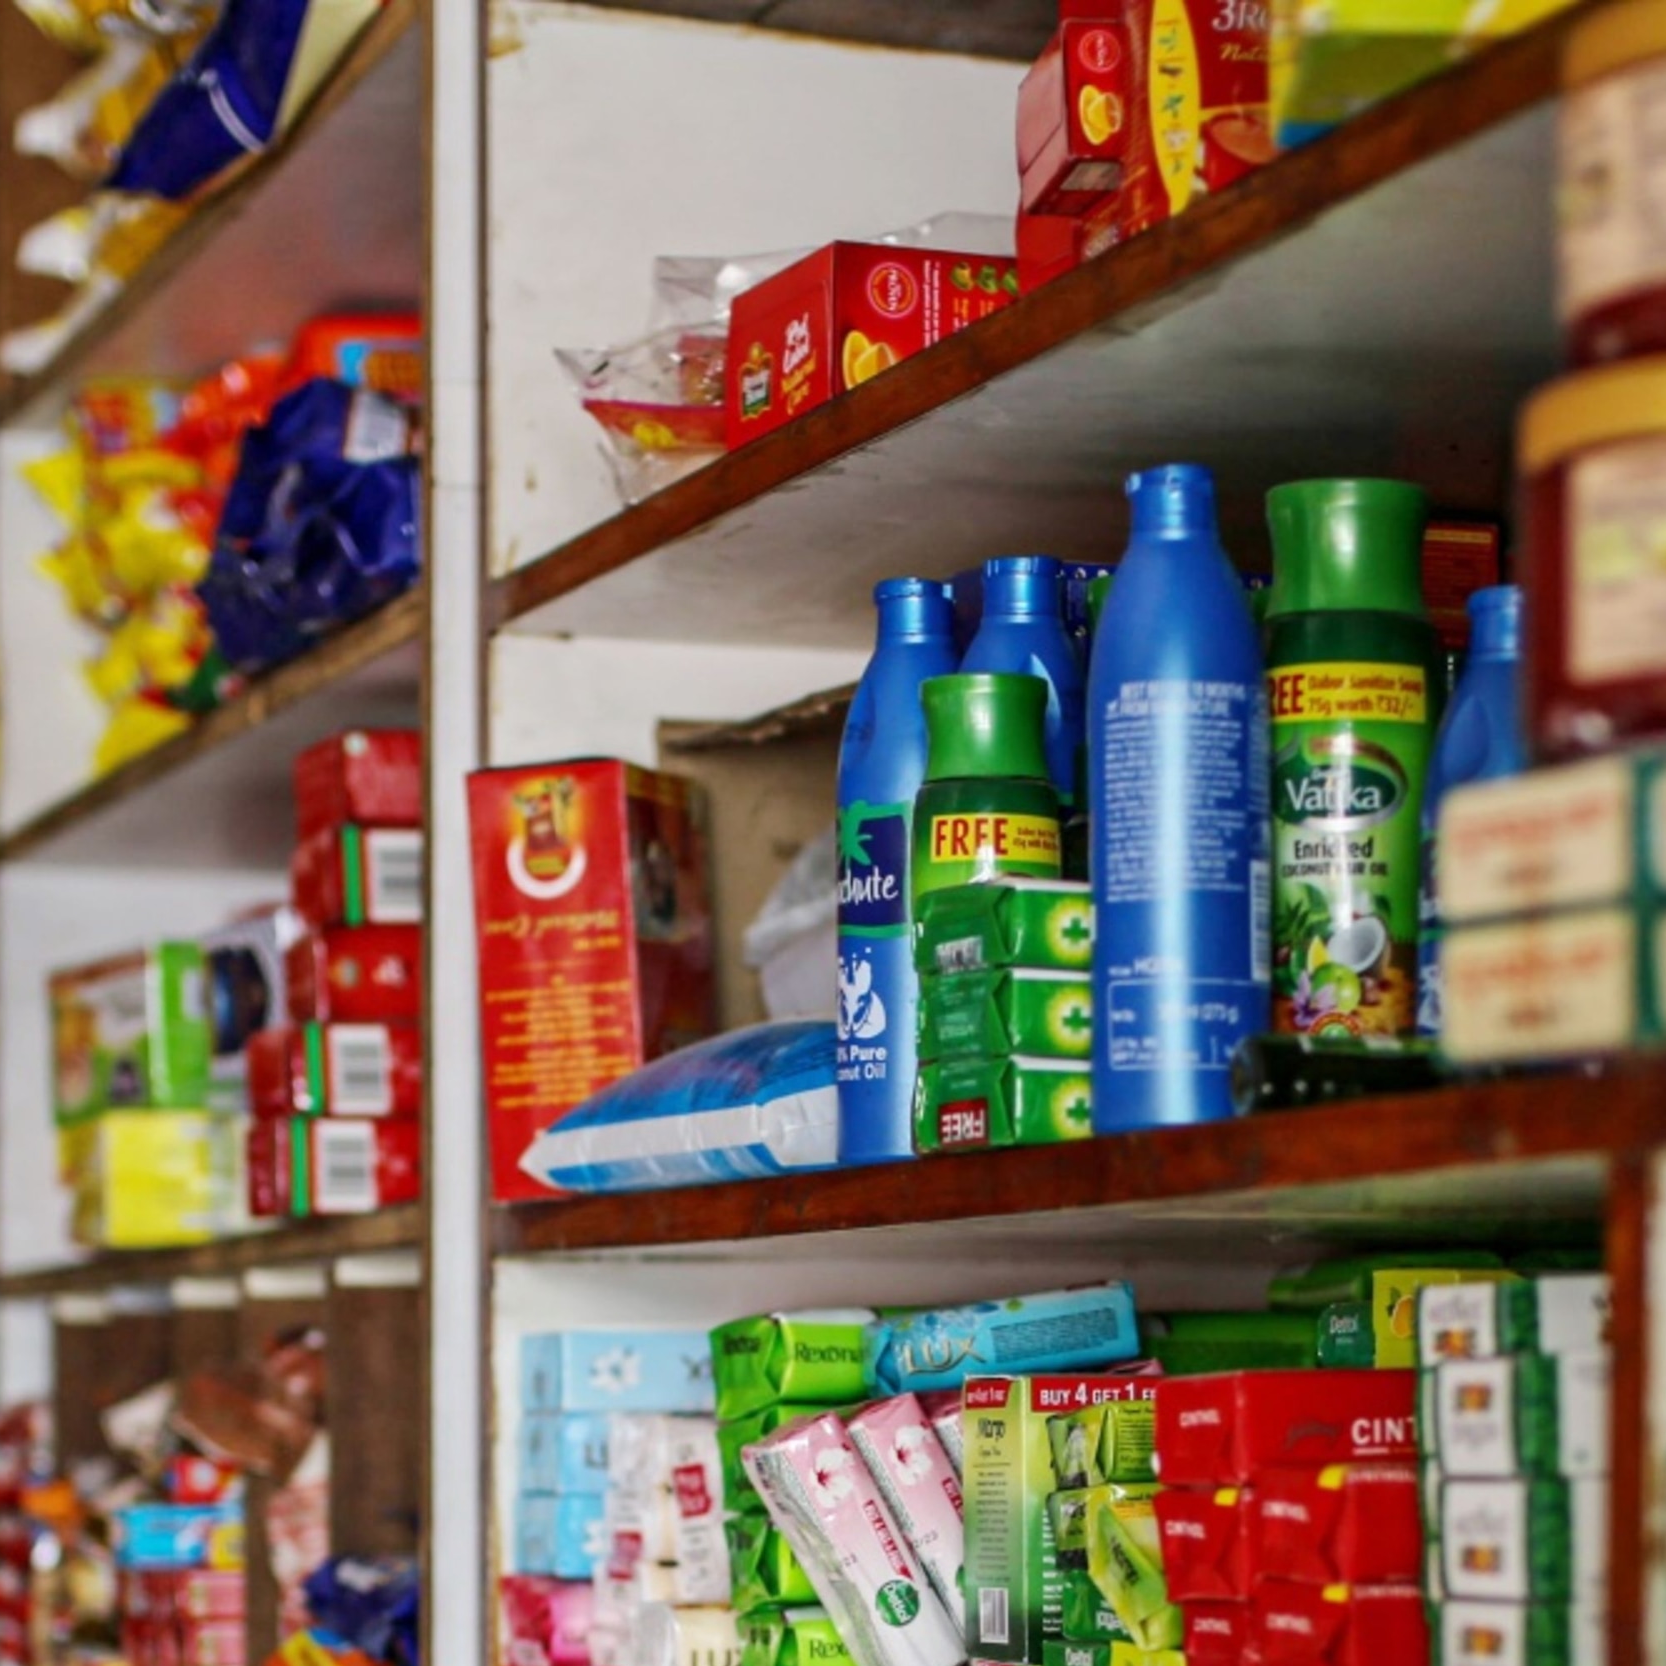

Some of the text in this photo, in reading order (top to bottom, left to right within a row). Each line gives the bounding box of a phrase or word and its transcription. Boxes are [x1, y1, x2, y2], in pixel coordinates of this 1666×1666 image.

[1285, 776, 1382, 811] Vatka
[935, 817, 1009, 857] FREE
[1294, 836, 1374, 861] Enriced
[850, 1045, 888, 1062] Pure
[864, 1063, 886, 1080] Oil
[941, 1111, 986, 1143] FREE
[903, 1336, 988, 1376] LUX
[1040, 1383, 1135, 1405] BUY 4 GET 1
